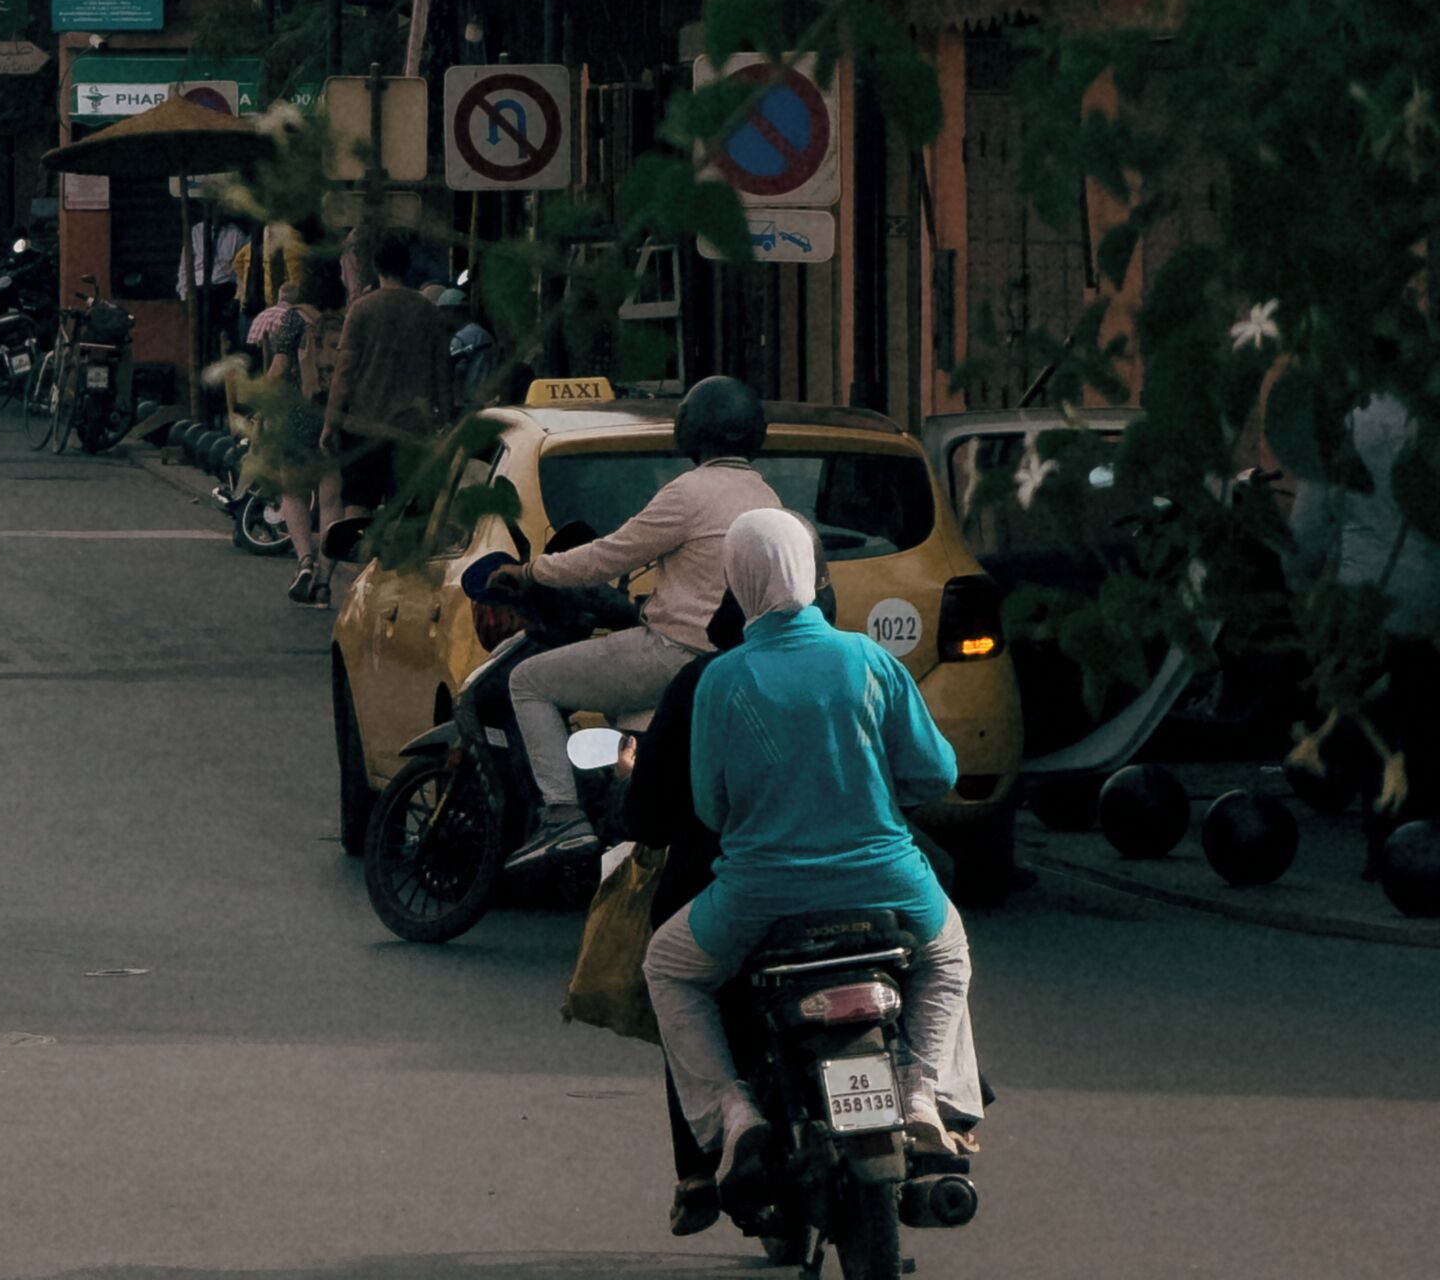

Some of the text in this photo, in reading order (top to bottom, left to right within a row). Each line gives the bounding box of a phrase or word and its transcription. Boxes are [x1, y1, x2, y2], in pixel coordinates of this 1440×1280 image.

[545, 383, 601, 399] TAXI
[873, 616, 917, 642] 1022
[849, 1073, 870, 1091] 26
[832, 1093, 894, 1115] 358138
